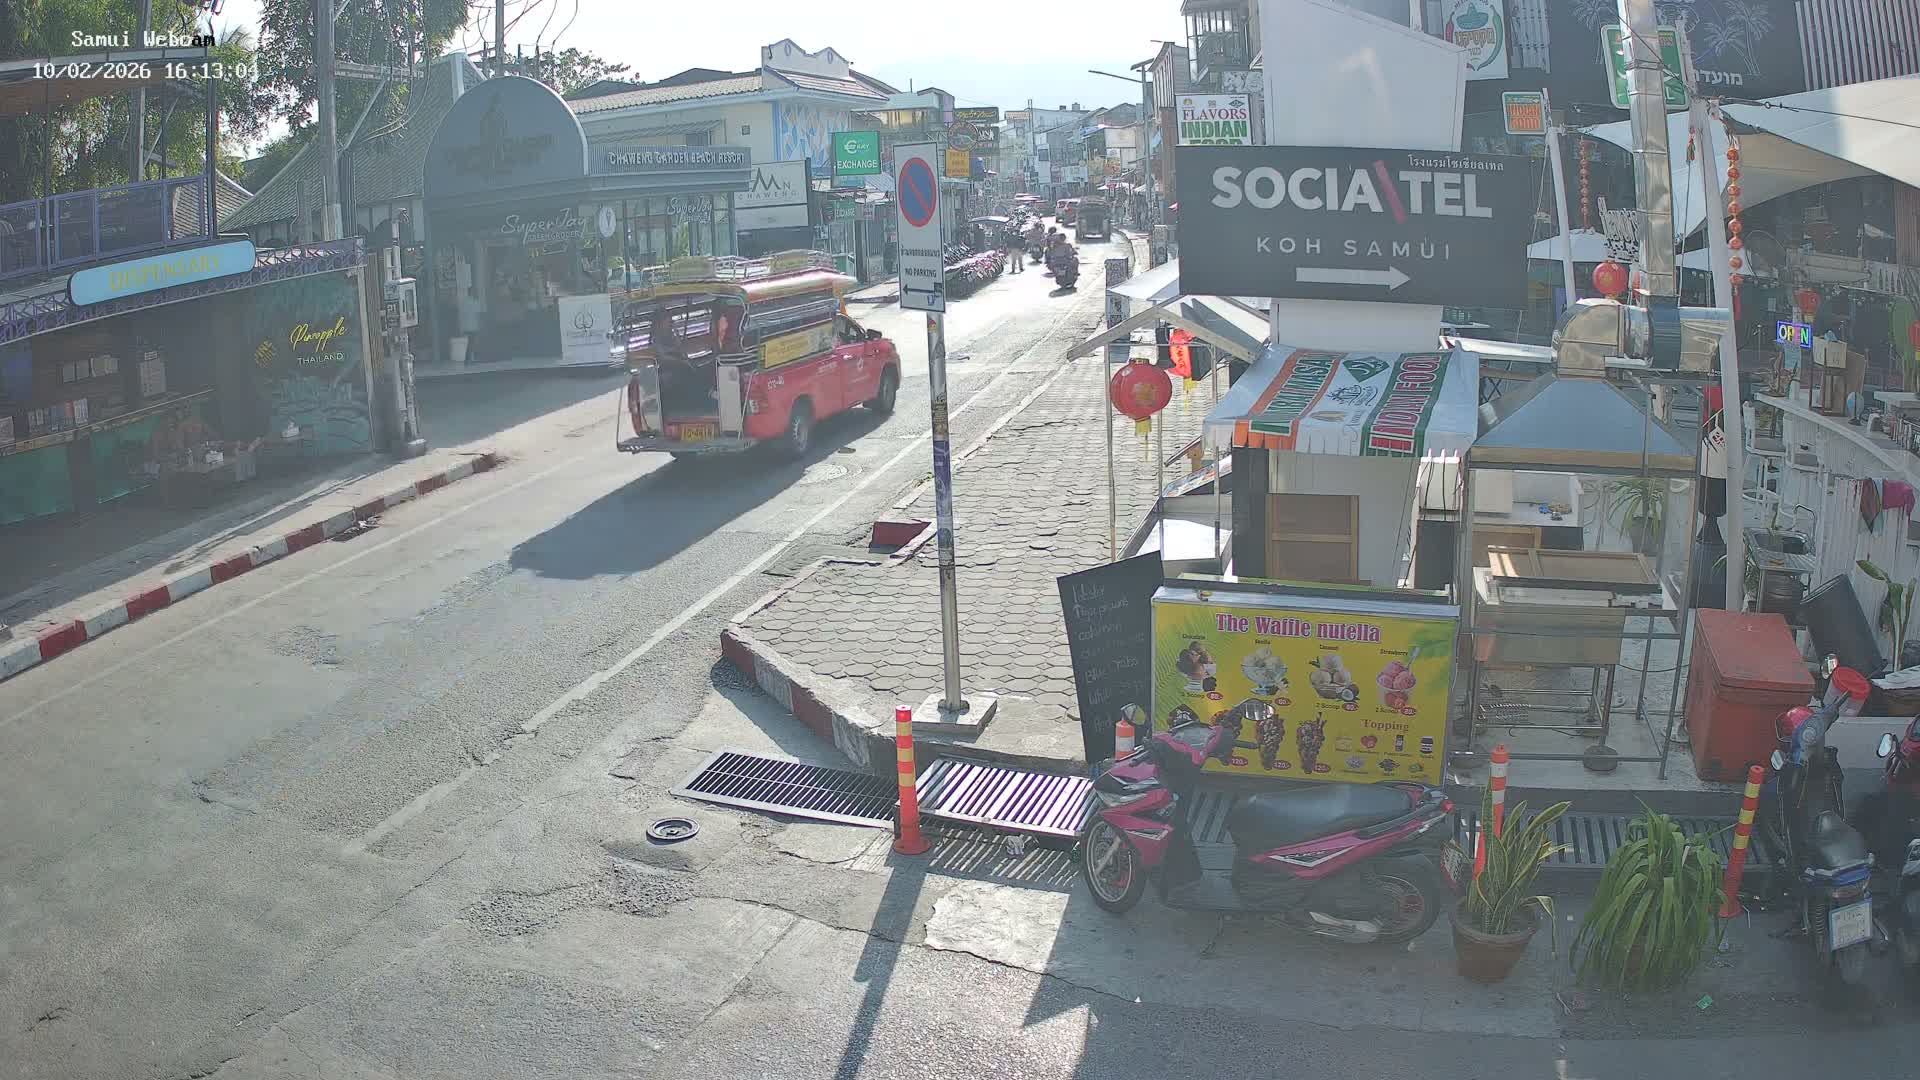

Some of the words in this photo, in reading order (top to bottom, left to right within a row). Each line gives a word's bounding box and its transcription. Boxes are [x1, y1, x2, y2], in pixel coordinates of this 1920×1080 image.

[1183, 108, 1247, 120] FLAVORS
[1181, 120, 1248, 138] INDIAN
[609, 151, 653, 165] CHAWENG
[655, 151, 689, 164] GARDEN
[691, 151, 716, 164] BEACH
[718, 152, 745, 164] RESORT
[837, 159, 878, 169] EXCHANGE
[1256, 236, 1322, 255] KOH
[1344, 239, 1450, 260] SAMUI
[110, 254, 223, 292] DISPENSARY
[905, 268, 912, 276] NO
[914, 268, 937, 278] PARKING
[1778, 323, 1809, 345] OPEN
[297, 352, 344, 366] THAILAND
[1368, 395, 1431, 454] INDIAN
[1216, 613, 1249, 633] The
[1254, 616, 1311, 638] Waffle
[1316, 622, 1381, 643] nutella
[1364, 720, 1409, 732] Topping
